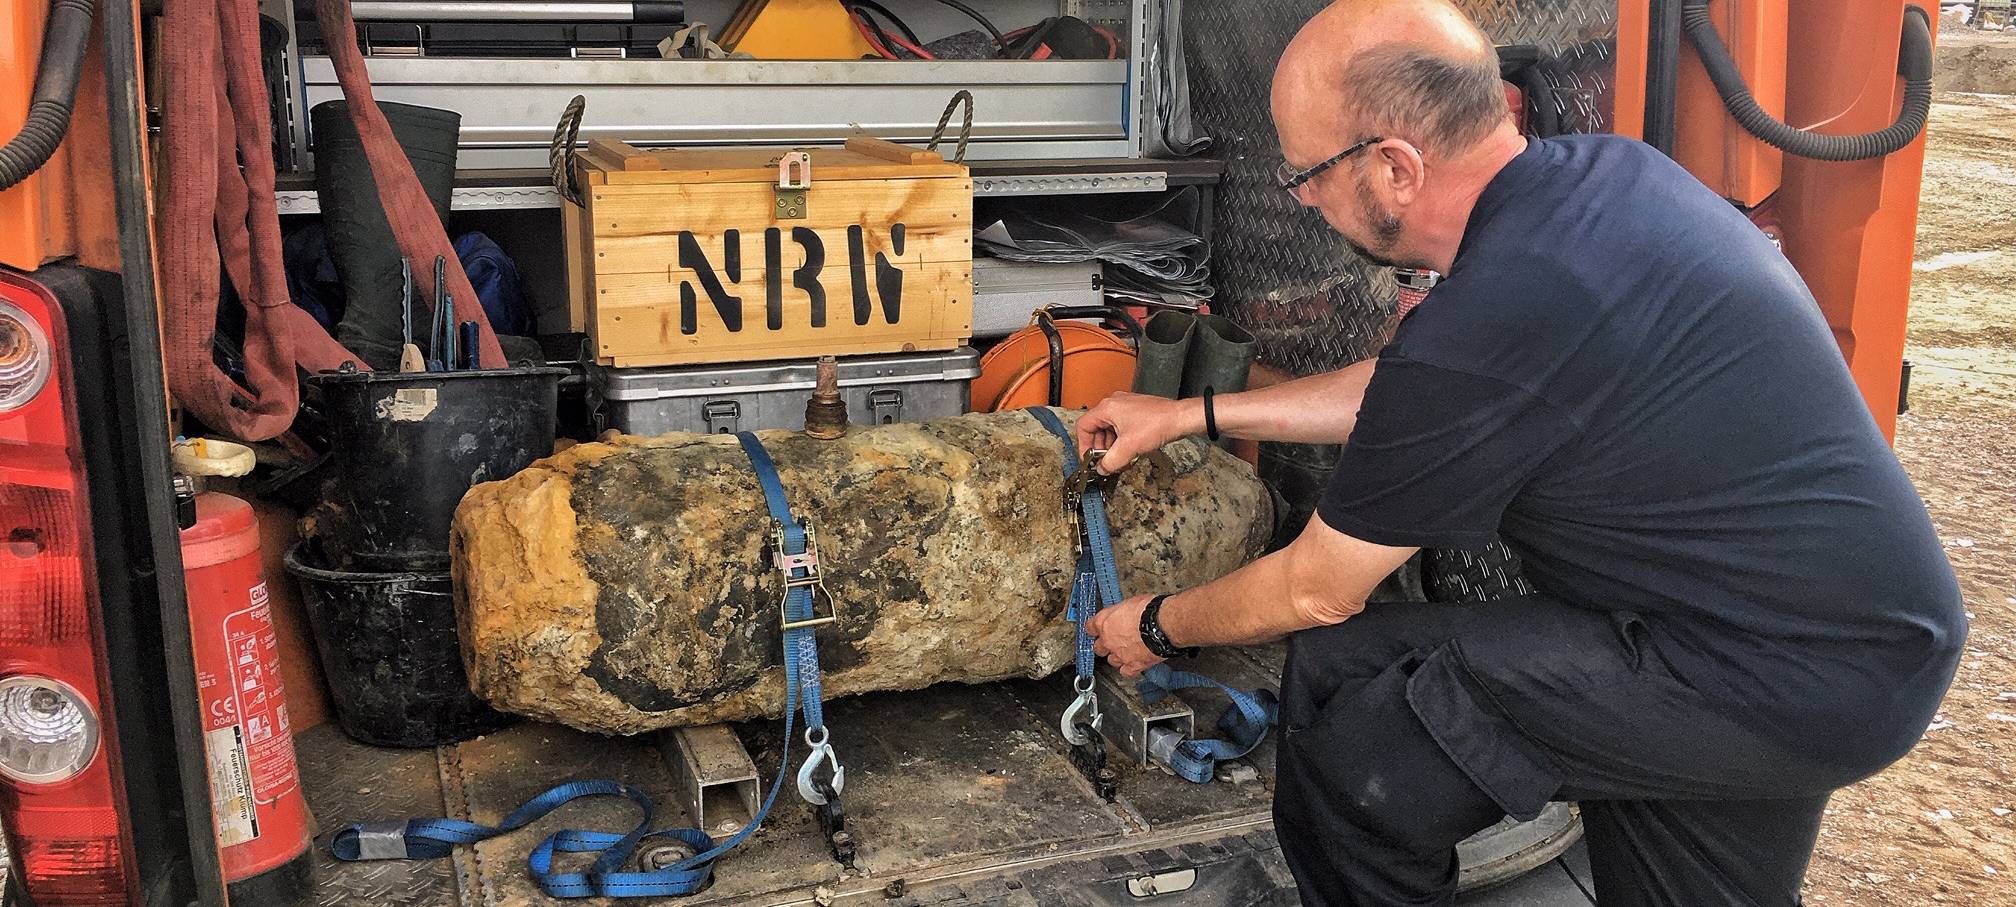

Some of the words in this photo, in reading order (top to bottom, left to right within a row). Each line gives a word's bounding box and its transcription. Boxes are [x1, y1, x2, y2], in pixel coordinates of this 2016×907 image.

[678, 222, 906, 335] NRW
[210, 696, 235, 717] CE
[230, 748, 244, 795] Feuerschutz
[238, 794, 249, 820] Klump
